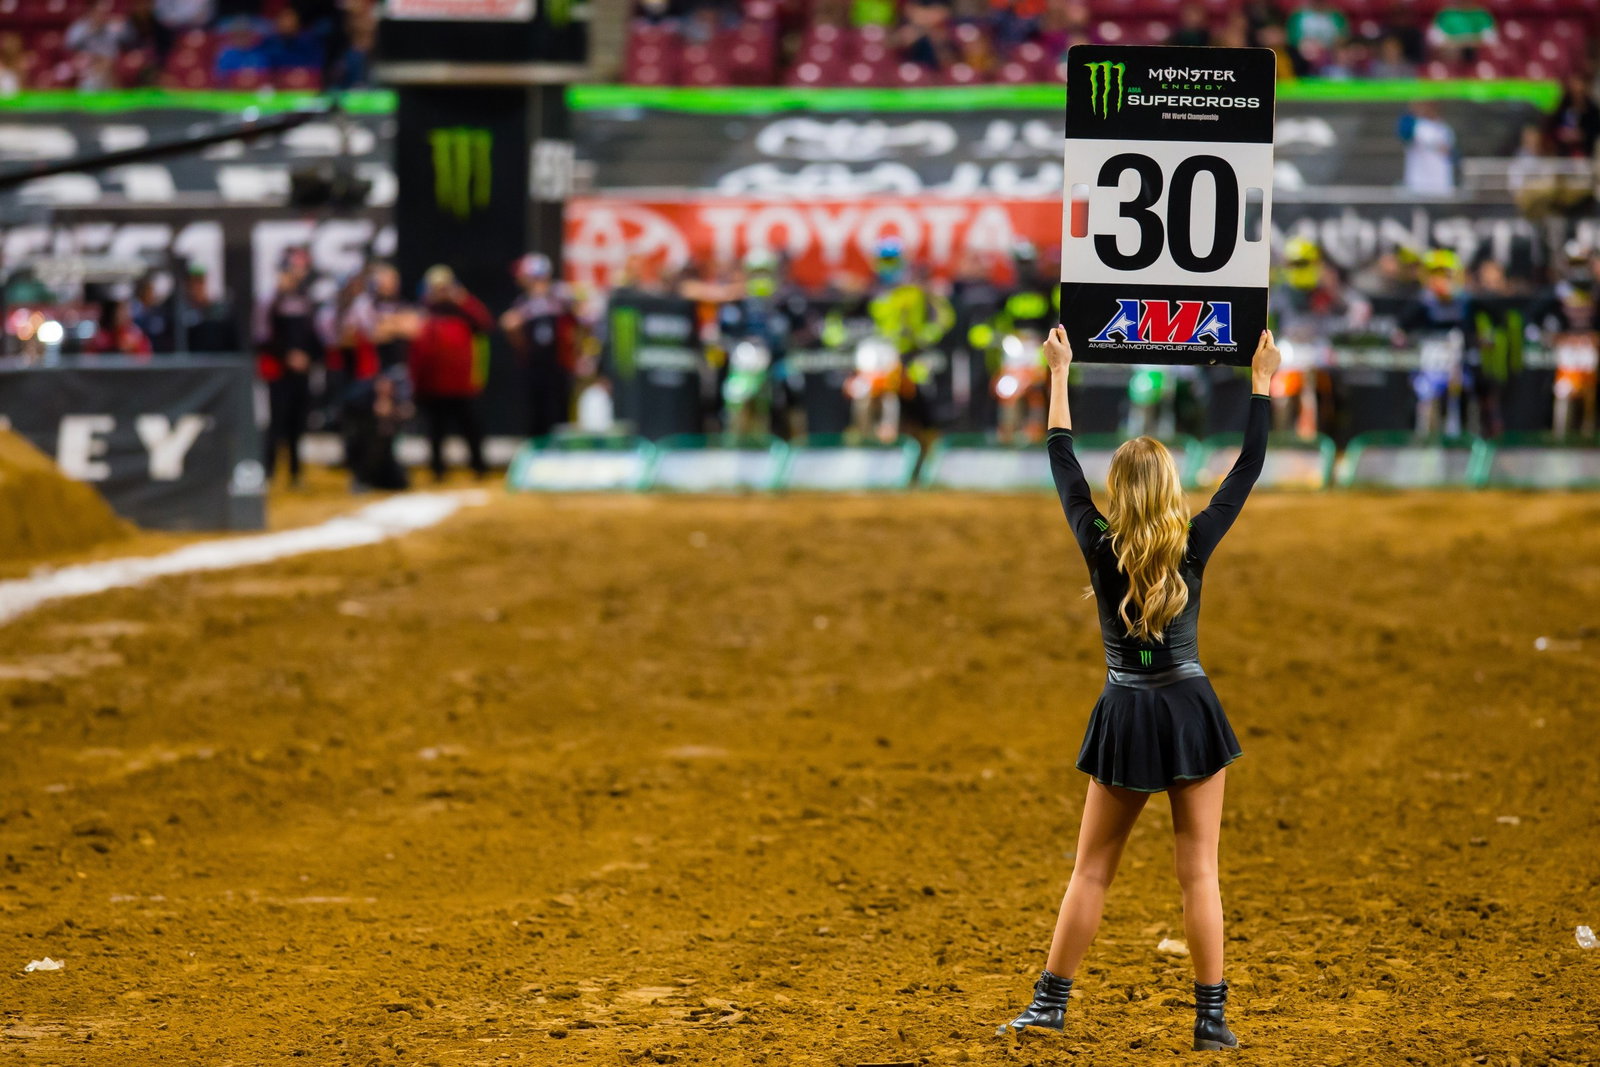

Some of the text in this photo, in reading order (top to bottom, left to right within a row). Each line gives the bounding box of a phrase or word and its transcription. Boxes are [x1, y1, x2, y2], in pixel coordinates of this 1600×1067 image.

[1127, 95, 1260, 108] SUPERCROSS
[1187, 113, 1219, 121] Championship
[1093, 153, 1239, 273] 30
[701, 204, 1019, 275] TOYOTA
[1088, 298, 1238, 346] AMA
[1088, 342, 1128, 350] AMERICAN
[1187, 345, 1238, 353] ASSOCIATION
